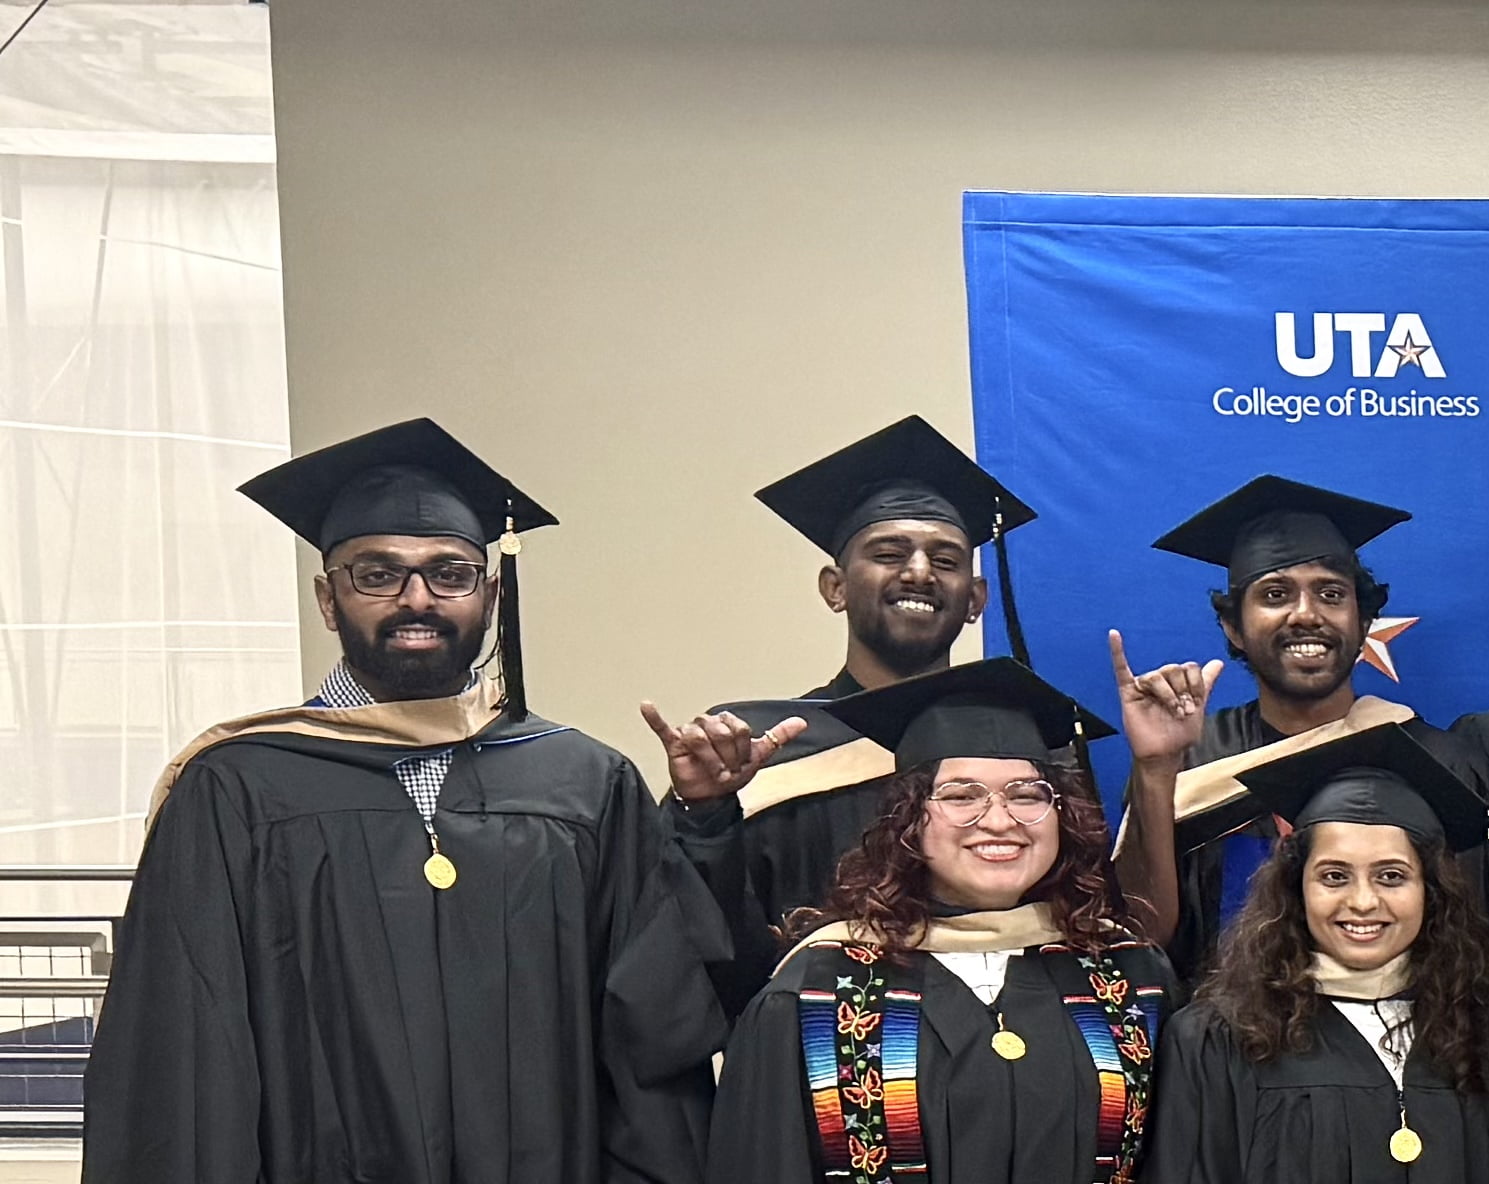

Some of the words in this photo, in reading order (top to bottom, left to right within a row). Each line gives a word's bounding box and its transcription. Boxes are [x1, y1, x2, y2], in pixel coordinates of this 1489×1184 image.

[1275, 312, 1447, 378] UTA
[1212, 387, 1321, 423] College
[1325, 387, 1357, 416] of
[1361, 388, 1480, 417] Business
